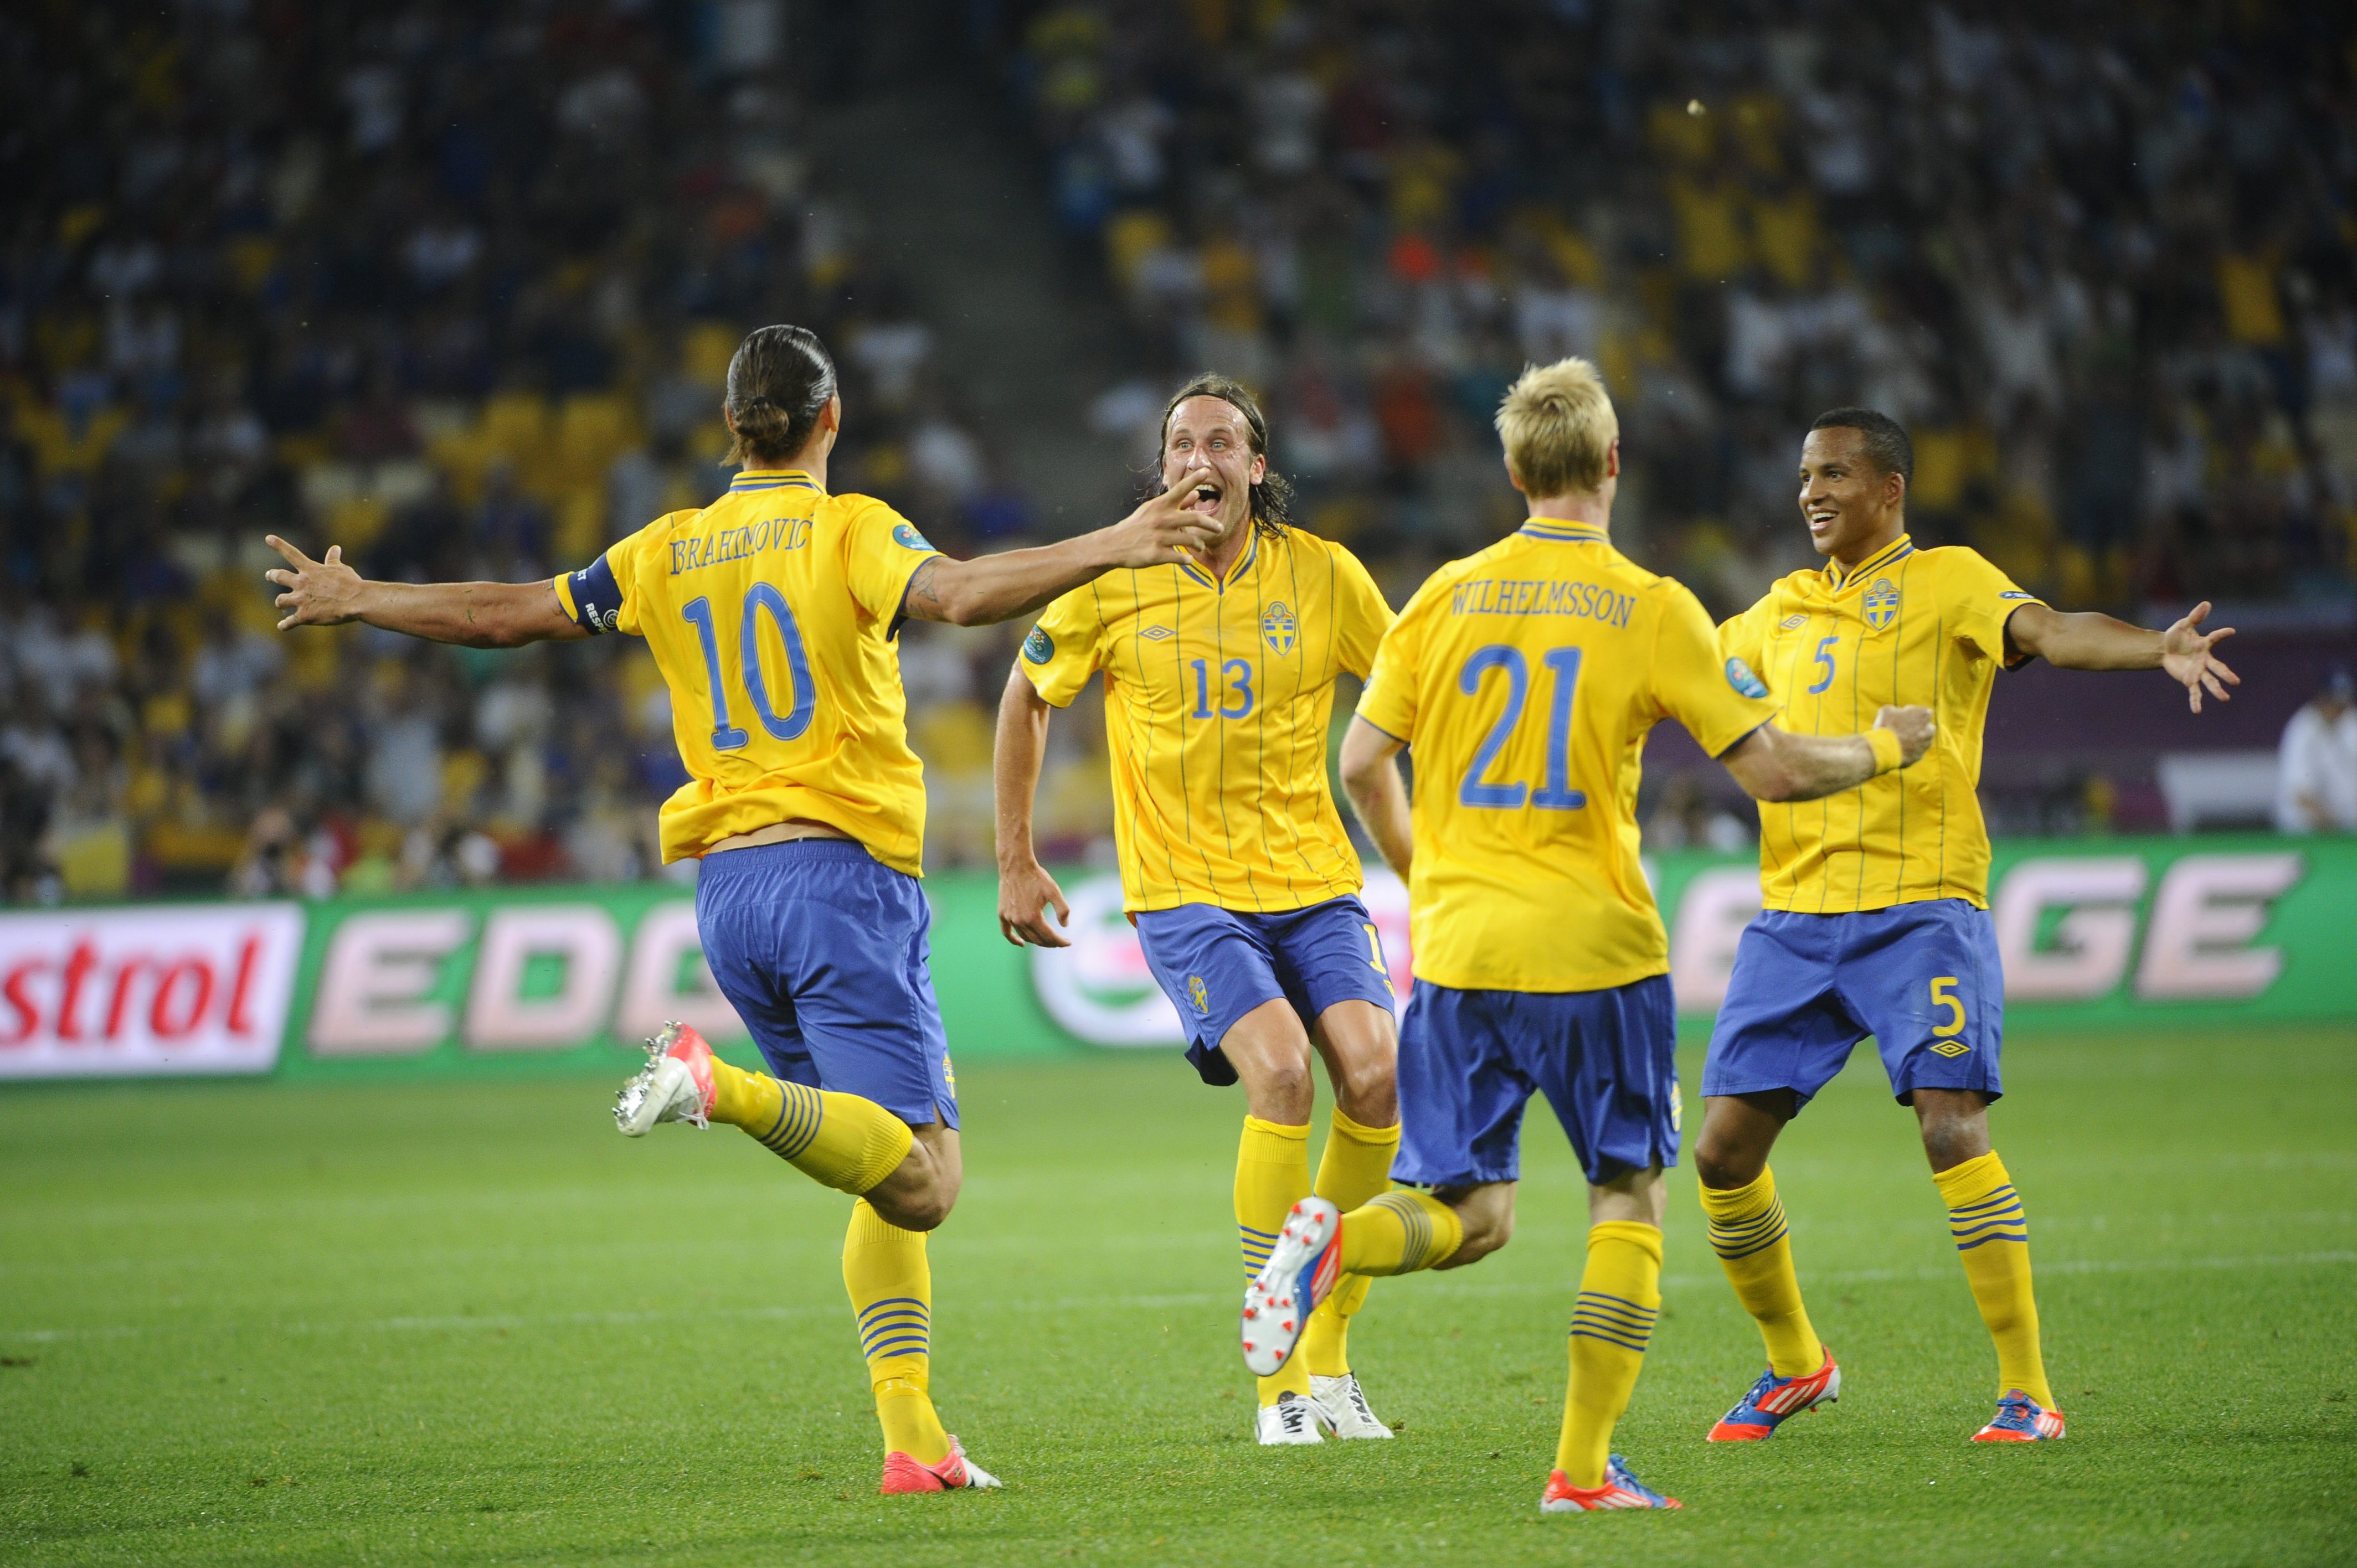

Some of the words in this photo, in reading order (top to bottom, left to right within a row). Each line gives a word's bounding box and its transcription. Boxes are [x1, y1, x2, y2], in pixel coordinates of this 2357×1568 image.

[1451, 579, 1636, 630] WILHELMSSON
[682, 581, 816, 751] 10
[1190, 659, 1254, 719] 13
[1808, 636, 1840, 694] 5
[1459, 643, 1587, 810] 21
[310, 902, 745, 1054] EDG
[1672, 853, 2303, 1009] EGE
[1930, 976, 1966, 1036] 5
